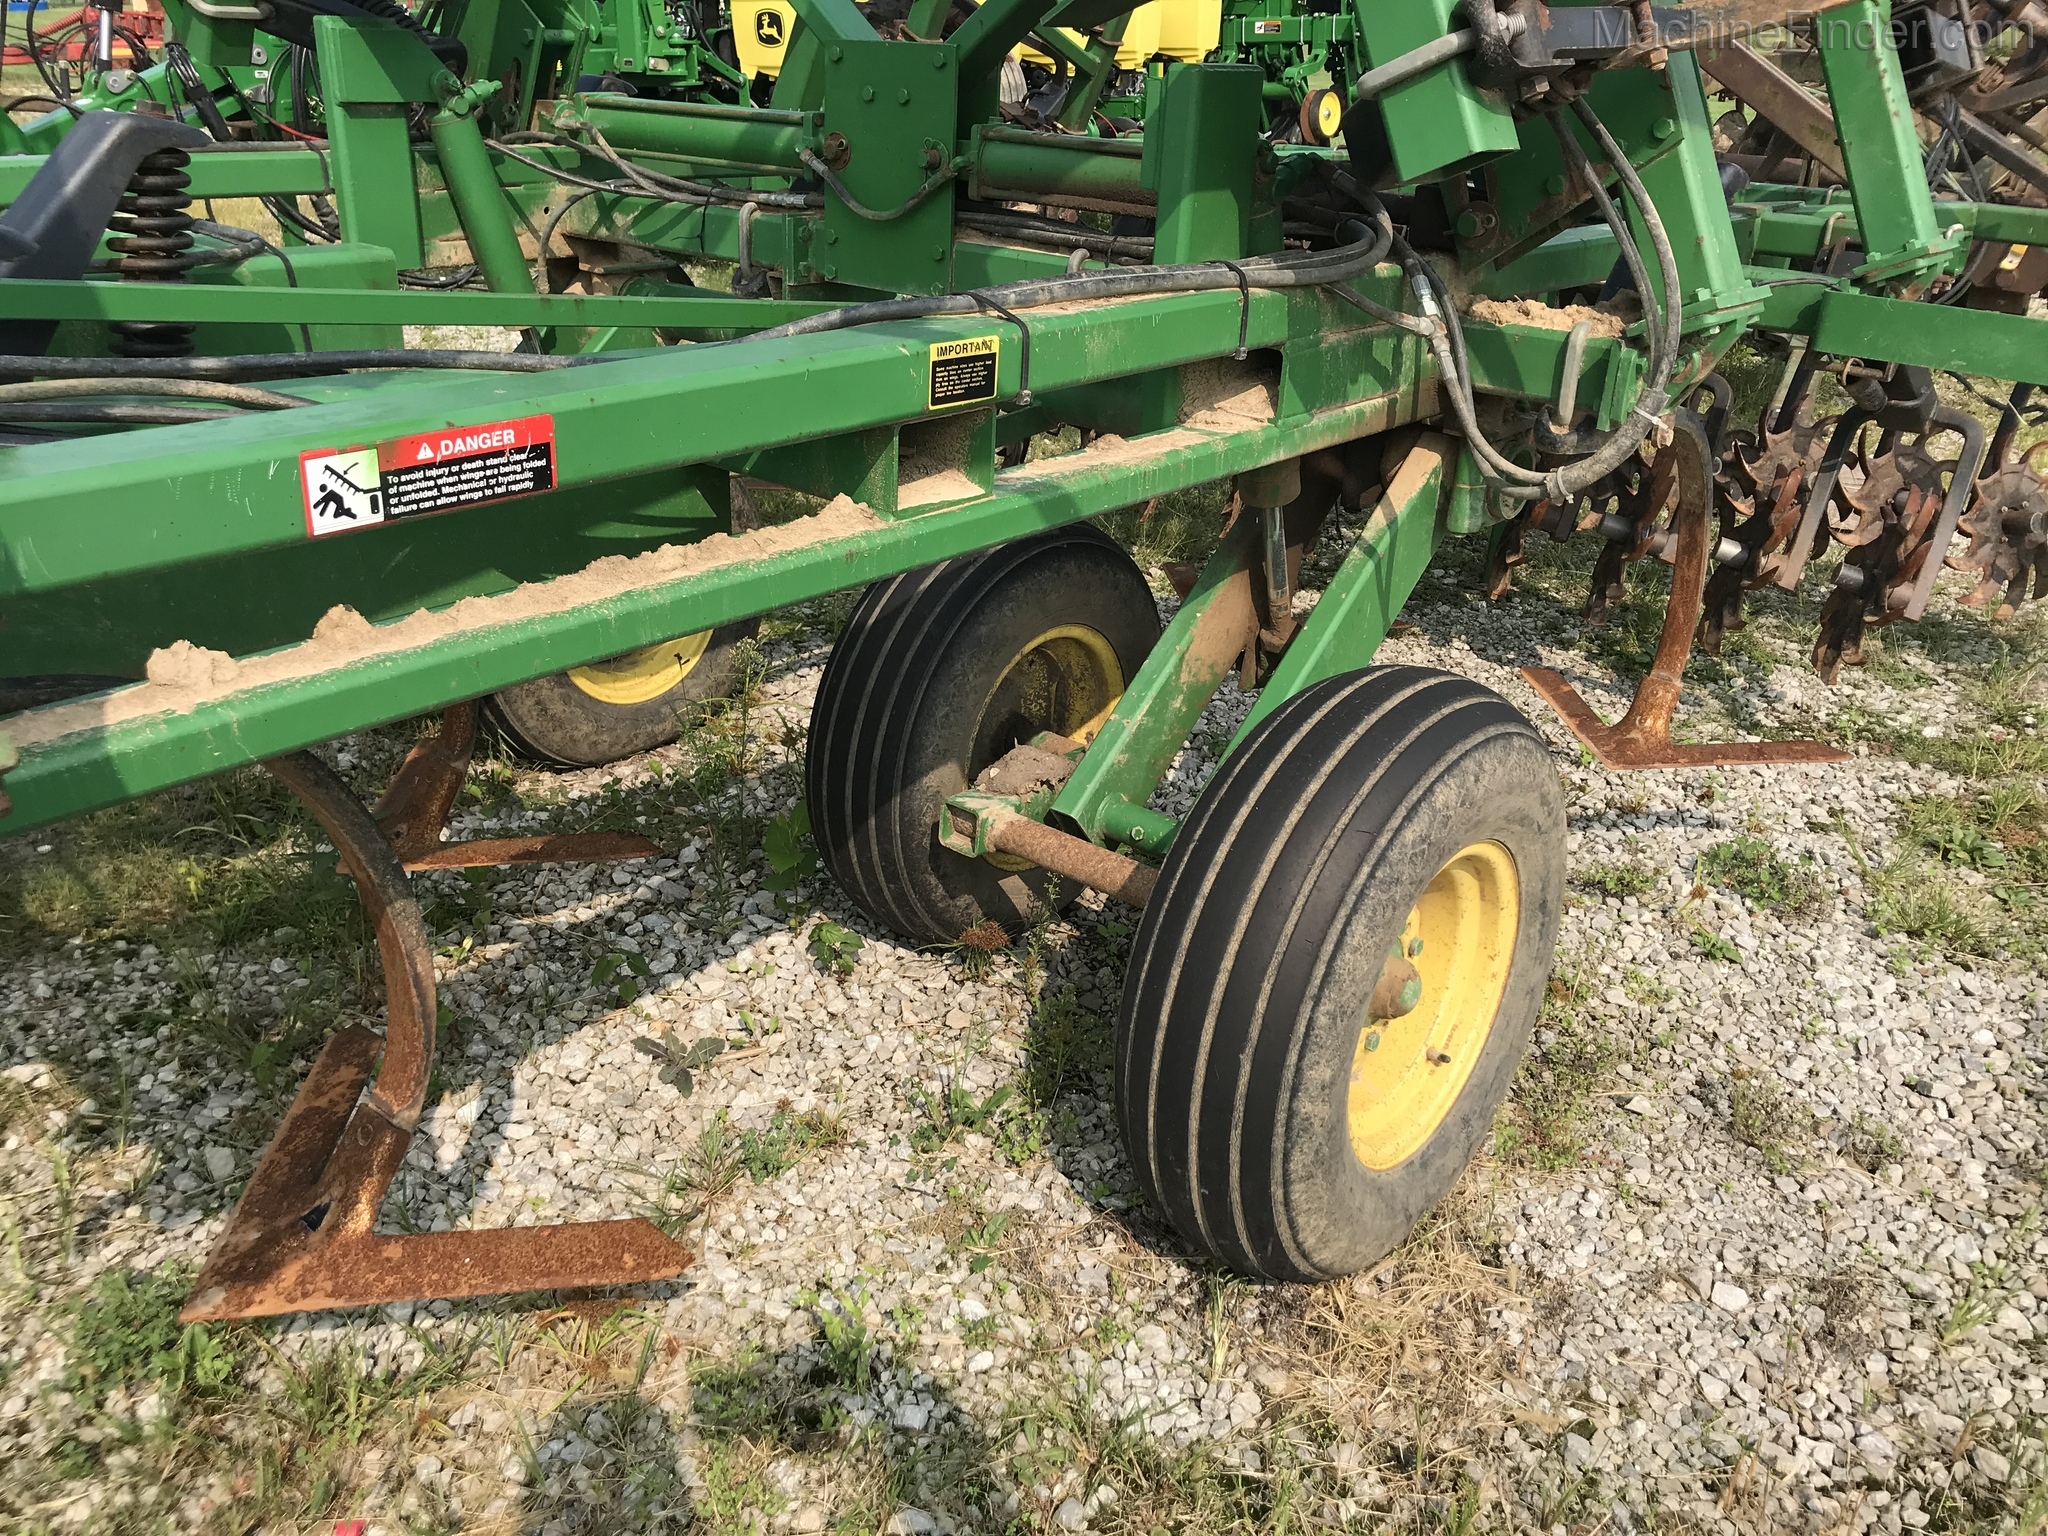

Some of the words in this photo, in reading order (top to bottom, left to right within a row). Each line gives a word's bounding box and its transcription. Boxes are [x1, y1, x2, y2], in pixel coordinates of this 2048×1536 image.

[937, 339, 993, 357] IMPORTANT
[440, 430, 515, 456] DANGER
[387, 476, 399, 484] To
[400, 470, 423, 482] avoid
[426, 467, 449, 477] injury
[462, 460, 484, 470] death
[486, 456, 508, 466] stand
[509, 453, 528, 462] clear
[388, 486, 397, 494] of
[399, 480, 435, 492] machine
[436, 475, 458, 485] when
[460, 471, 485, 480] wings
[500, 464, 521, 473] being
[523, 458, 546, 469] folded
[401, 488, 440, 502] unfolded.
[442, 479, 486, 494] Mechanical
[499, 471, 534, 484] hydraulic
[390, 504, 417, 514] failure
[419, 500, 434, 508] can
[436, 496, 457, 505] allow
[459, 491, 483, 499] wings
[494, 485, 506, 494] fall
[508, 481, 534, 491] rapidly
